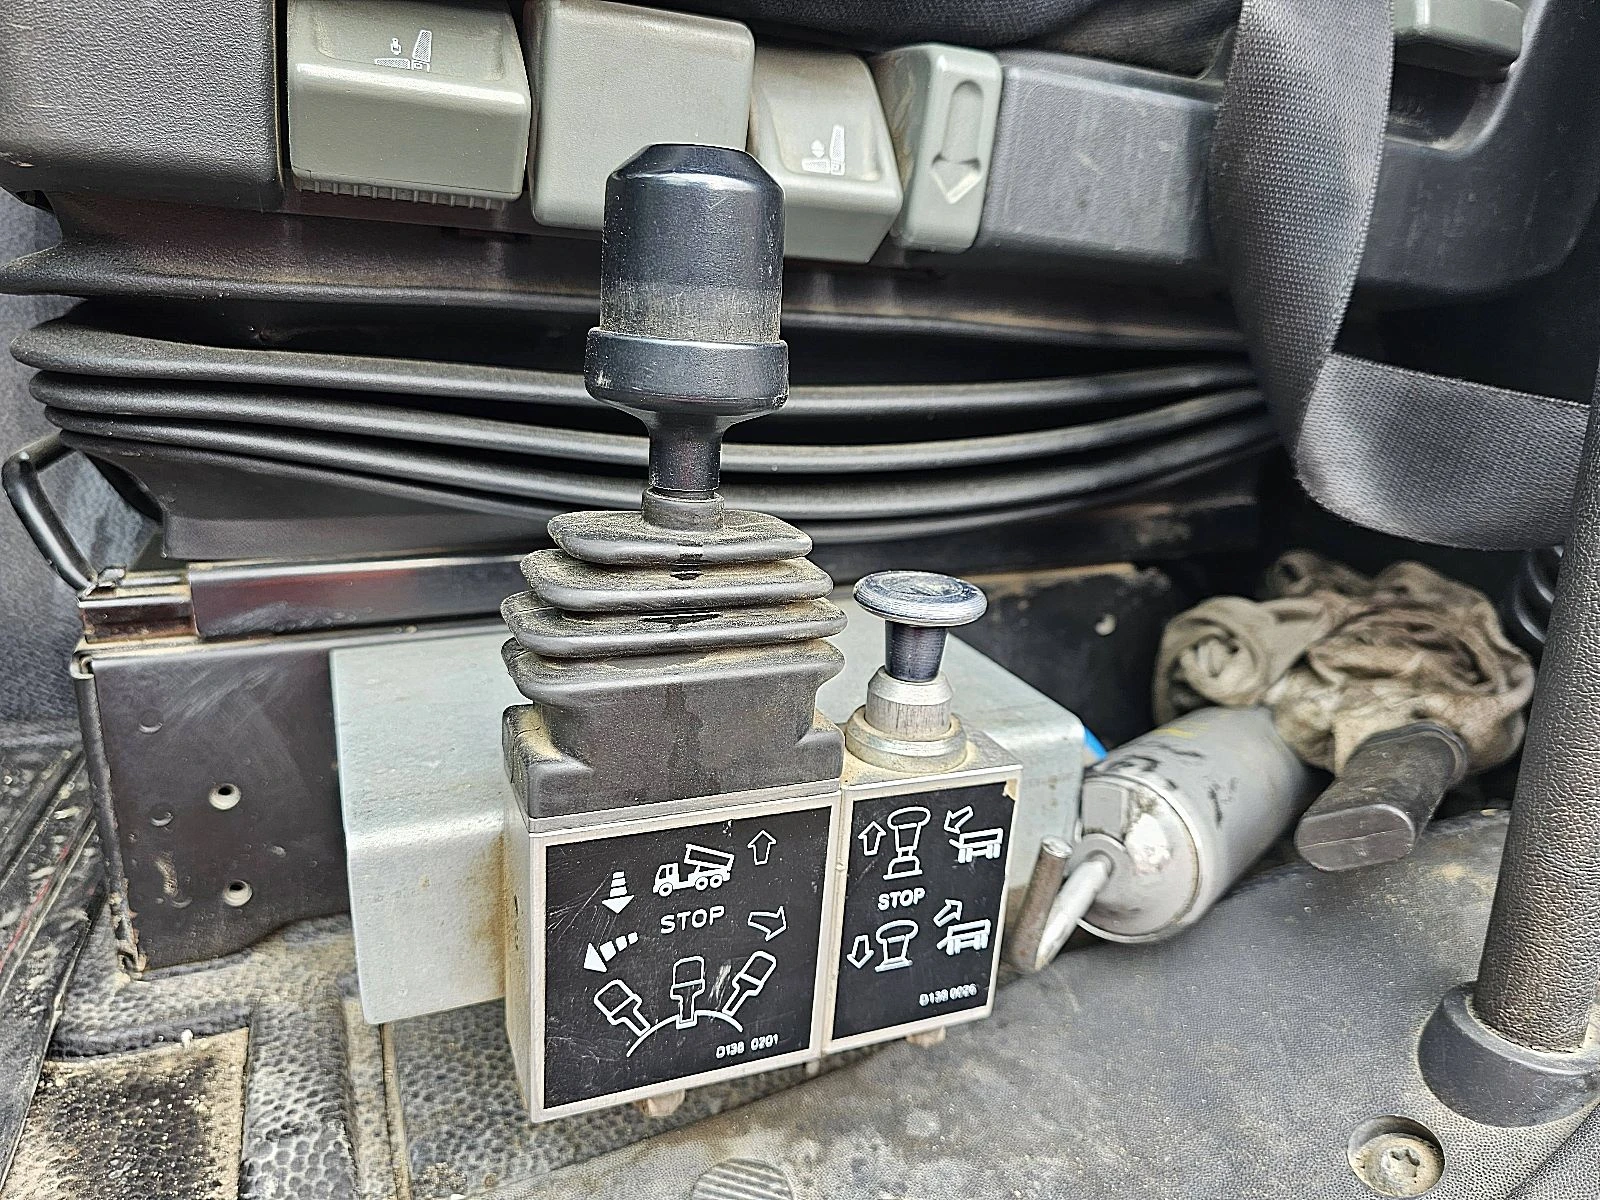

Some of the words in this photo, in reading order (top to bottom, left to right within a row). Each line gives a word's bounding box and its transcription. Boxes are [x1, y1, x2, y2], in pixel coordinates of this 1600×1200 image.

[878, 887, 926, 911] STOP
[660, 905, 725, 934] STOP
[750, 1033, 779, 1051] 0201
